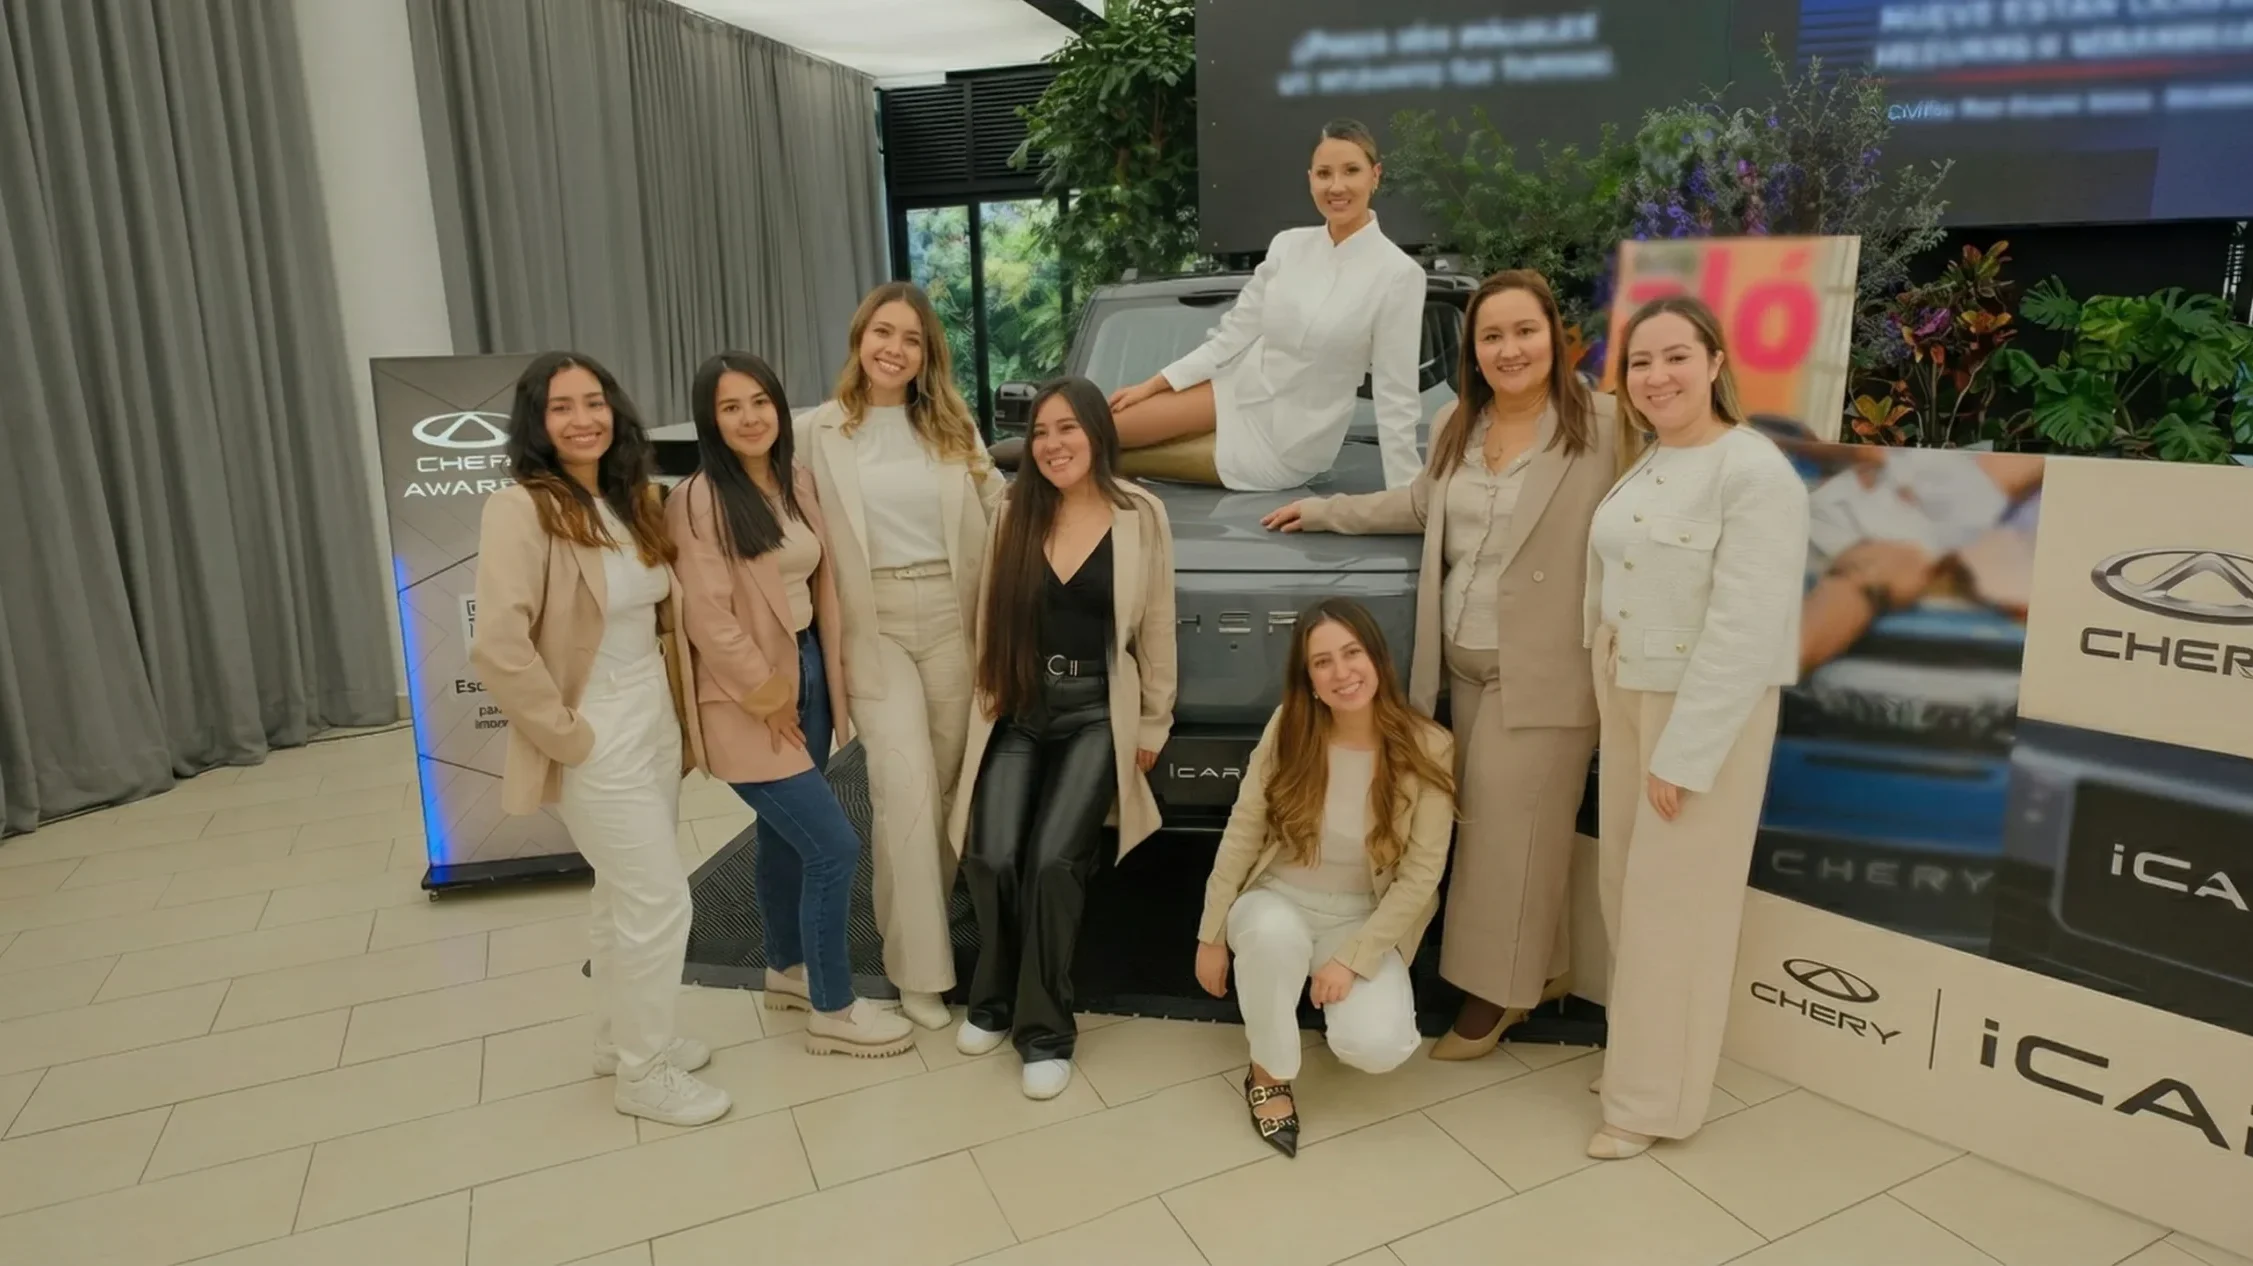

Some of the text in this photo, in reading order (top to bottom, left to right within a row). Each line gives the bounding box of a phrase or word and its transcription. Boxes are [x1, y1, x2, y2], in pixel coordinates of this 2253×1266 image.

[416, 454, 512, 472] CHER
[403, 478, 518, 498] AWAR
[2080, 627, 2253, 675] CHER
[1771, 848, 1996, 895] CHERY
[2111, 843, 2250, 912] iCA
[1750, 981, 2253, 1159] CHERY iCA
